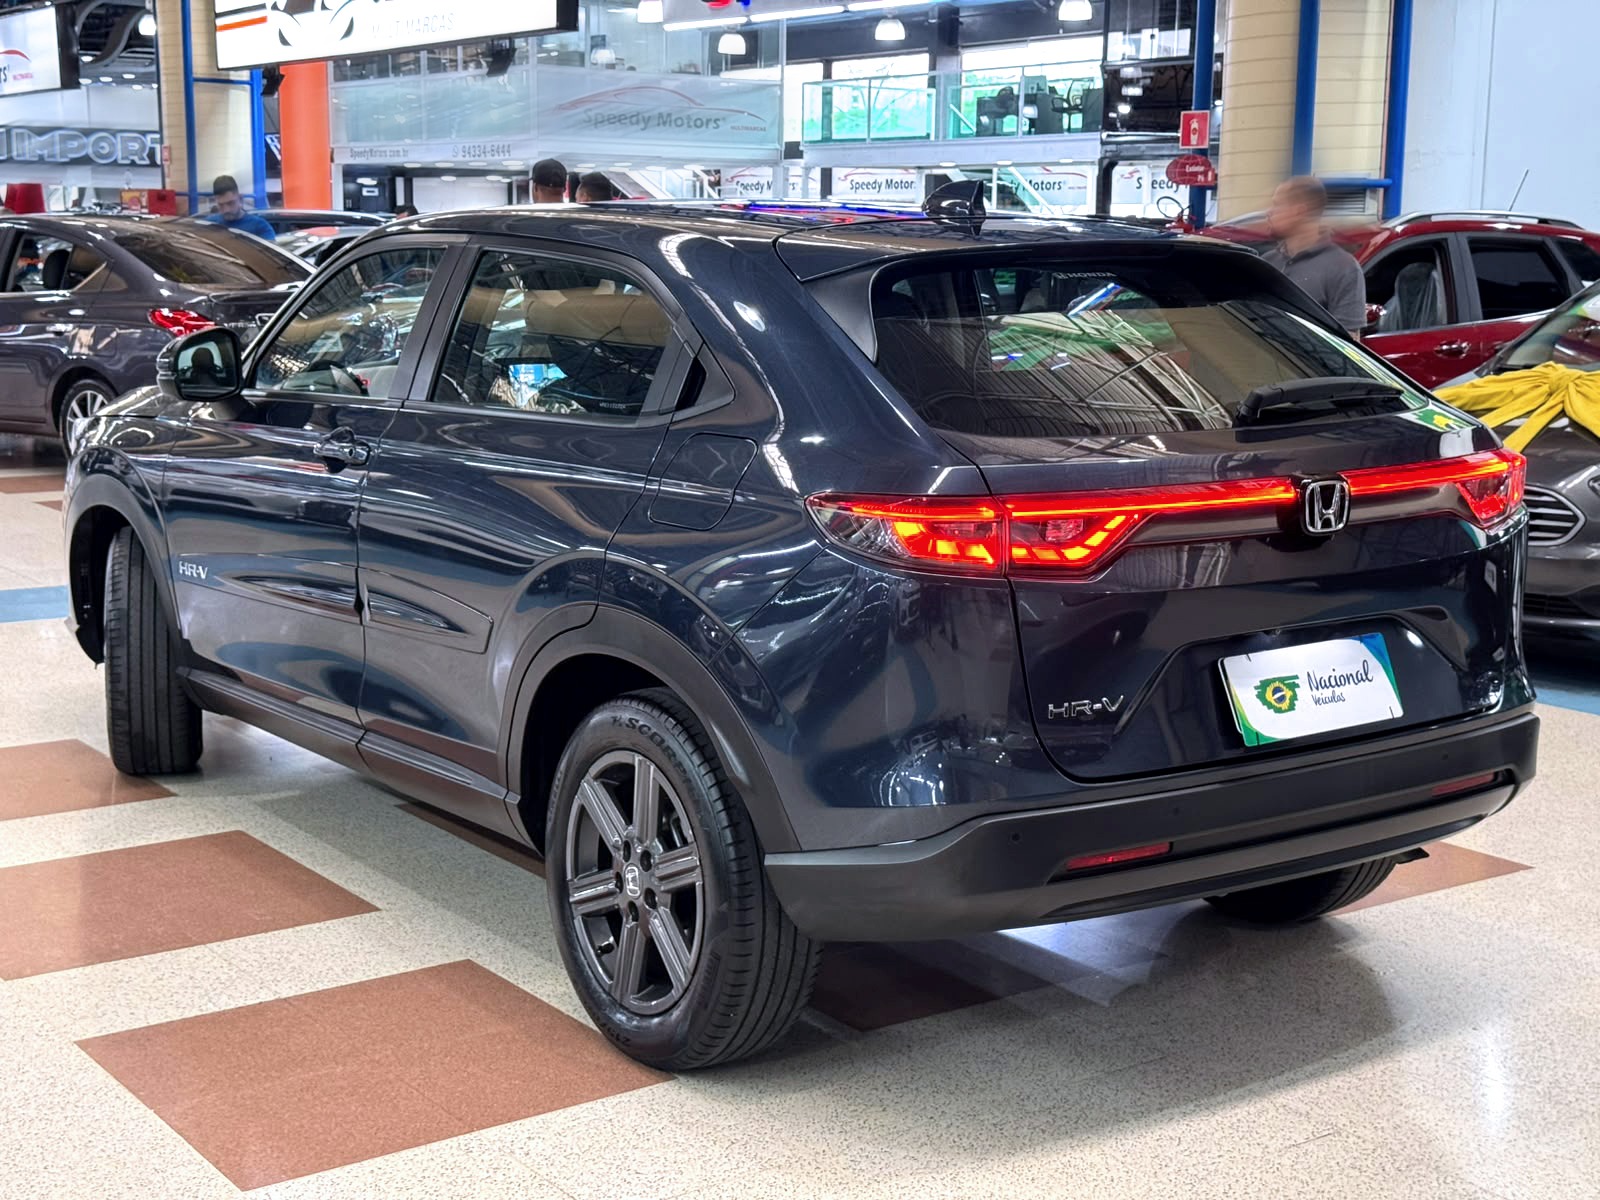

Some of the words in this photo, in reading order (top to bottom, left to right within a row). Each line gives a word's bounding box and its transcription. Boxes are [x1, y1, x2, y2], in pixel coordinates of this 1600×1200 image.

[583, 108, 651, 131] Speedy
[657, 111, 721, 130] Motors
[849, 178, 883, 194] Speedy
[885, 178, 916, 190] Motor
[1136, 177, 1180, 193] Seedy
[179, 560, 208, 580] HR-V
[1306, 659, 1374, 692] Nacional
[1048, 695, 1124, 719] HR-V
